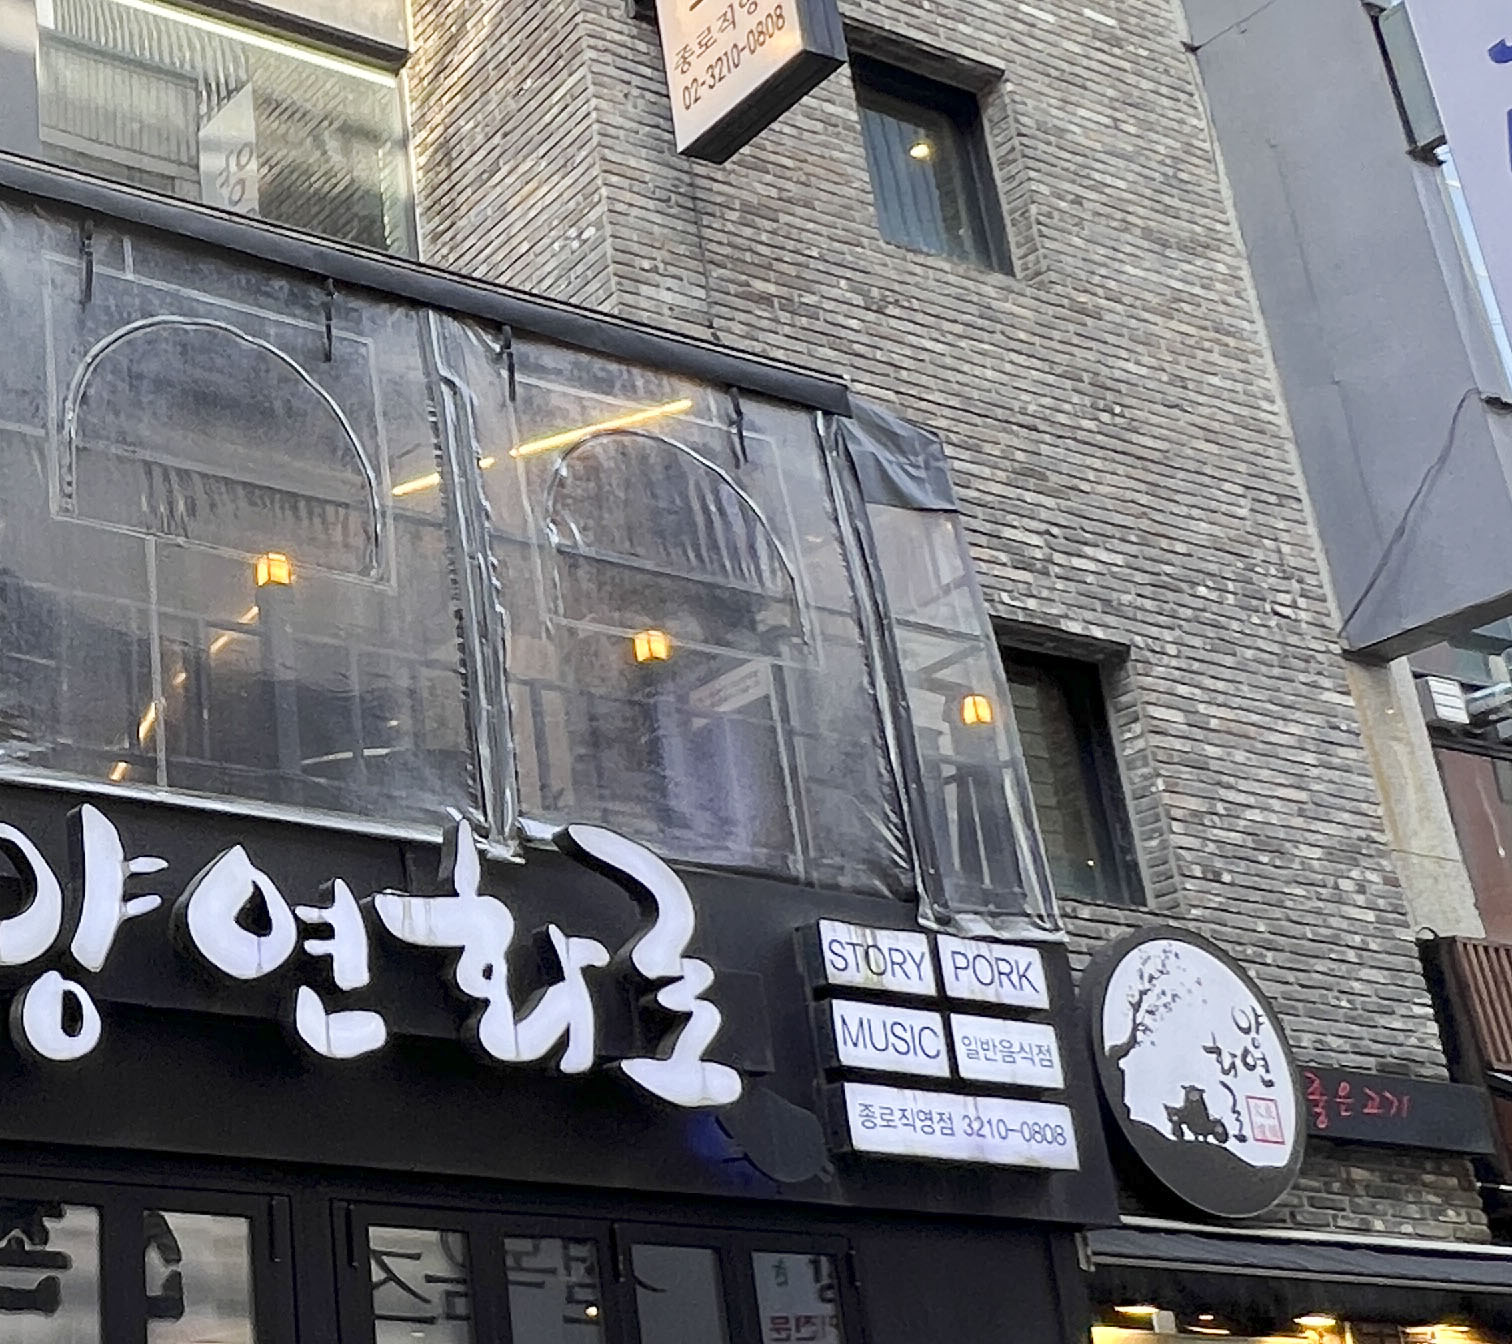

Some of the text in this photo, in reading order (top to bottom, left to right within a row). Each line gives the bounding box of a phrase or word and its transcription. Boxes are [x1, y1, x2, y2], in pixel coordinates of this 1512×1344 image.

[682, 4, 786, 111] 02-3210-0808
[828, 938, 926, 983] STORY
[950, 950, 1040, 994] PORK
[840, 1013, 942, 1060] MUSIC
[960, 1034, 1055, 1069] 일반음식점
[857, 1101, 1068, 1147] 종로직영점 3210-0808
